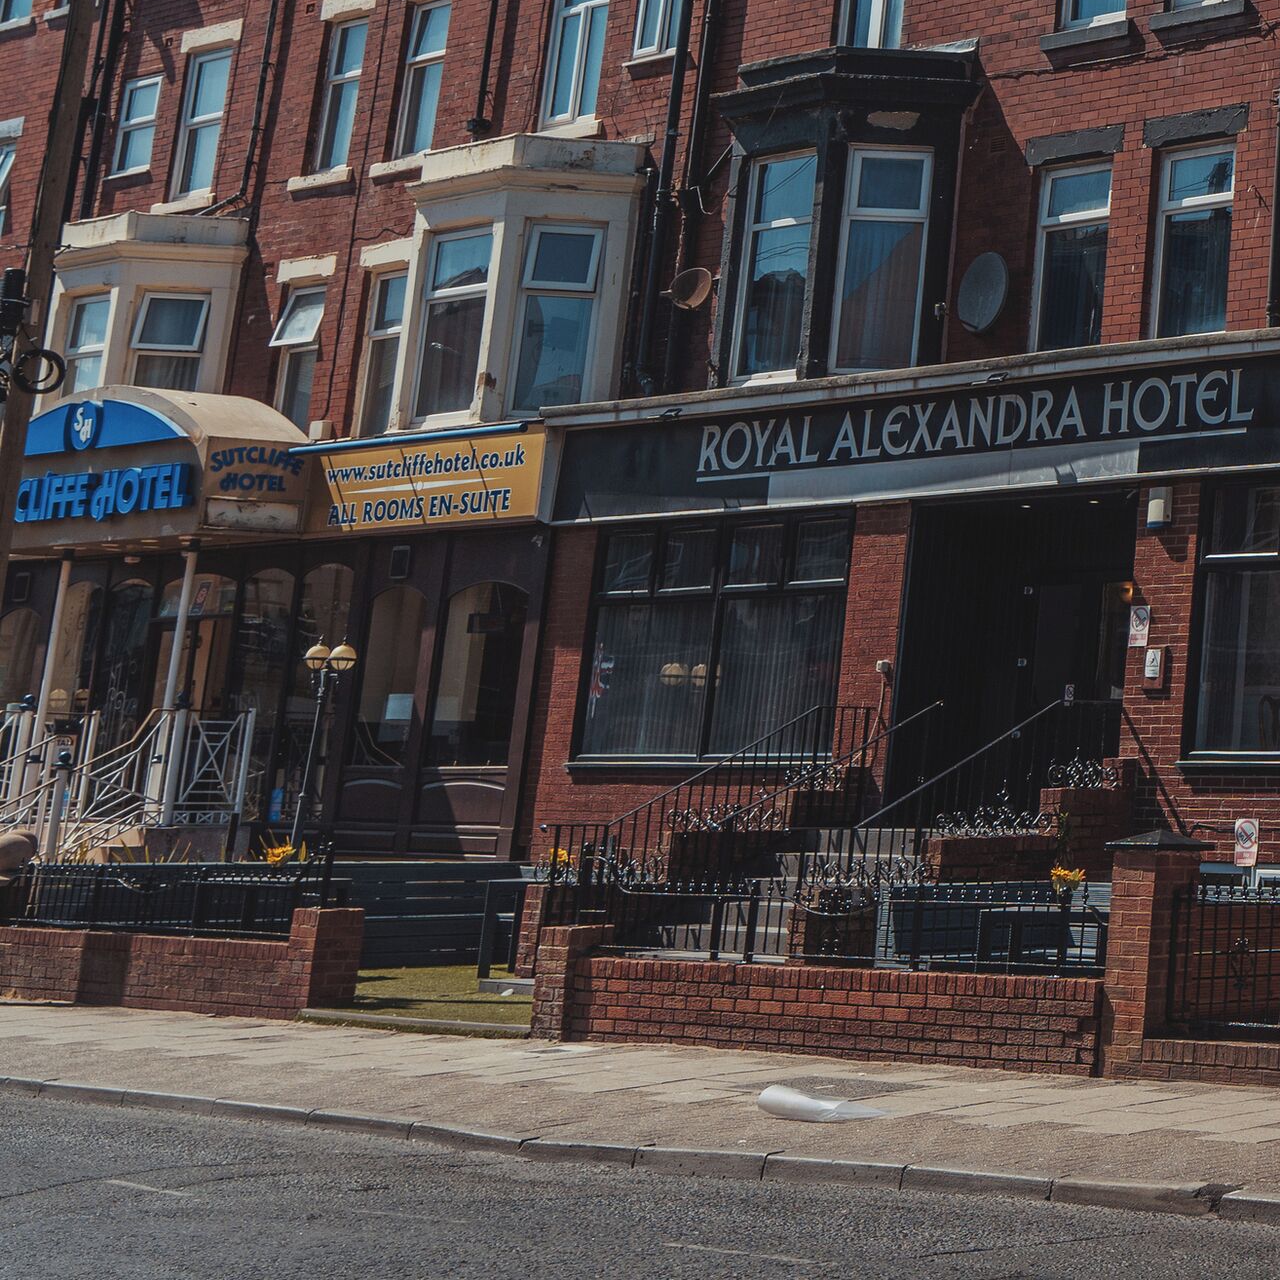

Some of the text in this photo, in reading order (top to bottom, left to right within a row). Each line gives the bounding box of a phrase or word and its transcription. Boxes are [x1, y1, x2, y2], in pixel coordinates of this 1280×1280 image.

[696, 367, 1256, 472] ROYAL ALEXANDRA HOTEL
[209, 445, 305, 476] SUTCLIFFE
[326, 441, 526, 486] www.sutcliffehotel.co.uk
[89, 461, 194, 523] HOTEL
[218, 472, 287, 493] HOTEL
[326, 487, 512, 527] ALL ROOMS EN-SUITE
